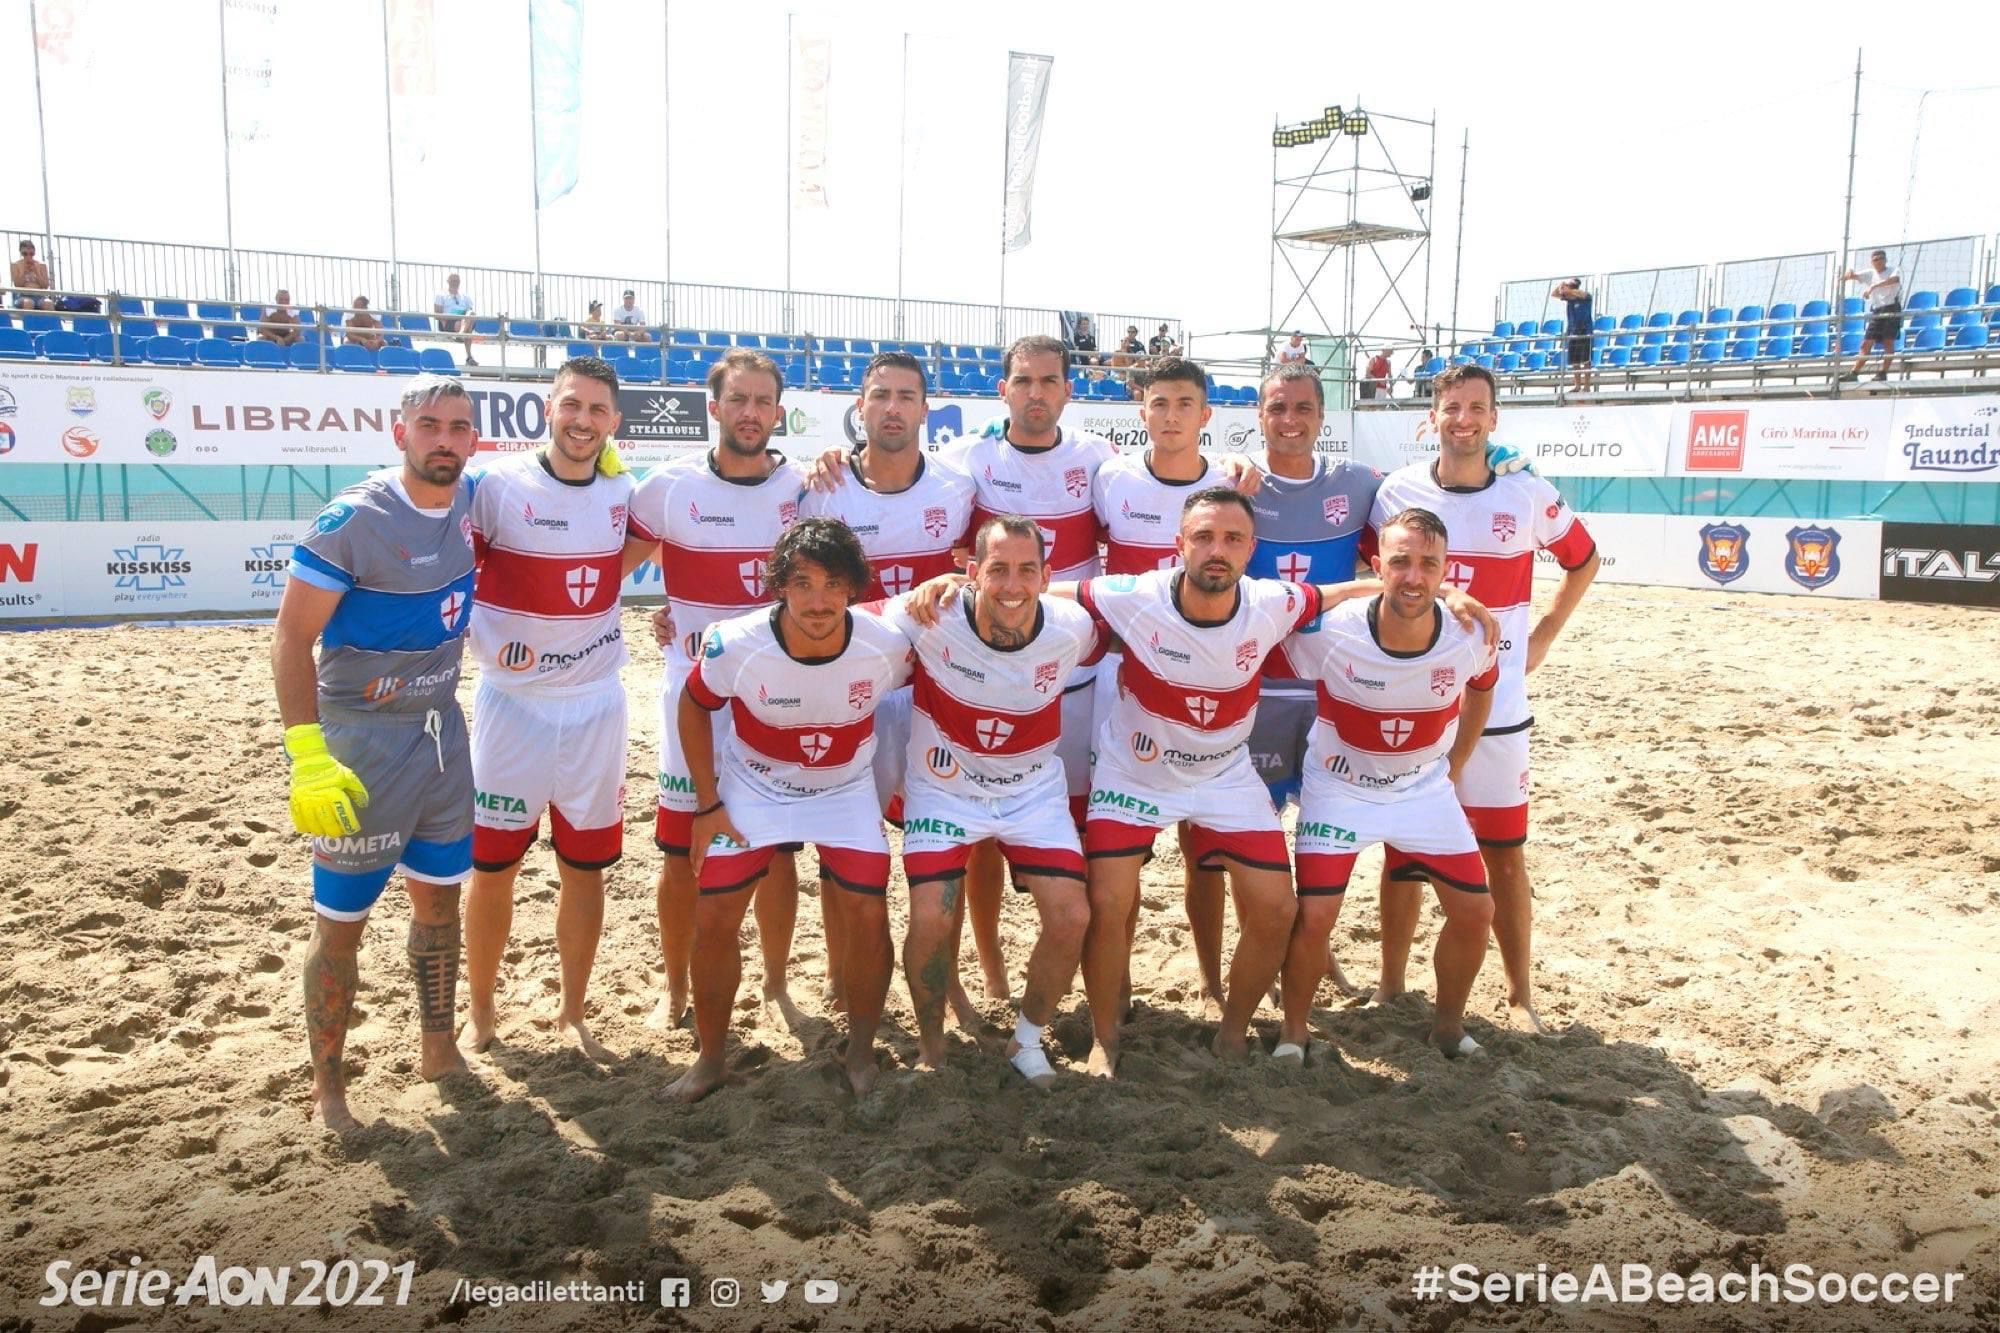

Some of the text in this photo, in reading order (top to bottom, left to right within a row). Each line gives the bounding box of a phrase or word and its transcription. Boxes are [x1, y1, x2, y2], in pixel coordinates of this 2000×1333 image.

[1084, 417, 1142, 428] BEACH SOCCE
[629, 425, 701, 435] STEAKHOUSE
[1693, 424, 1739, 447] AMG
[1761, 426, 1870, 441] Cirò Marina (Kr)
[1905, 423, 1989, 440] Industrial
[1536, 443, 1623, 457] IPPOLITO
[534, 518, 568, 526] GIORDANI
[700, 515, 734, 523] GIORDANI
[1130, 512, 1161, 520] GIORDANI
[107, 561, 191, 575] KISSKISS
[115, 591, 187, 602] play everywhere
[251, 590, 270, 598] play
[1159, 647, 1190, 660] GIORDANI
[950, 662, 985, 680] GIORDANI
[1354, 676, 1385, 686] GIORDANI
[474, 789, 528, 814] META
[904, 817, 966, 837] OMETA
